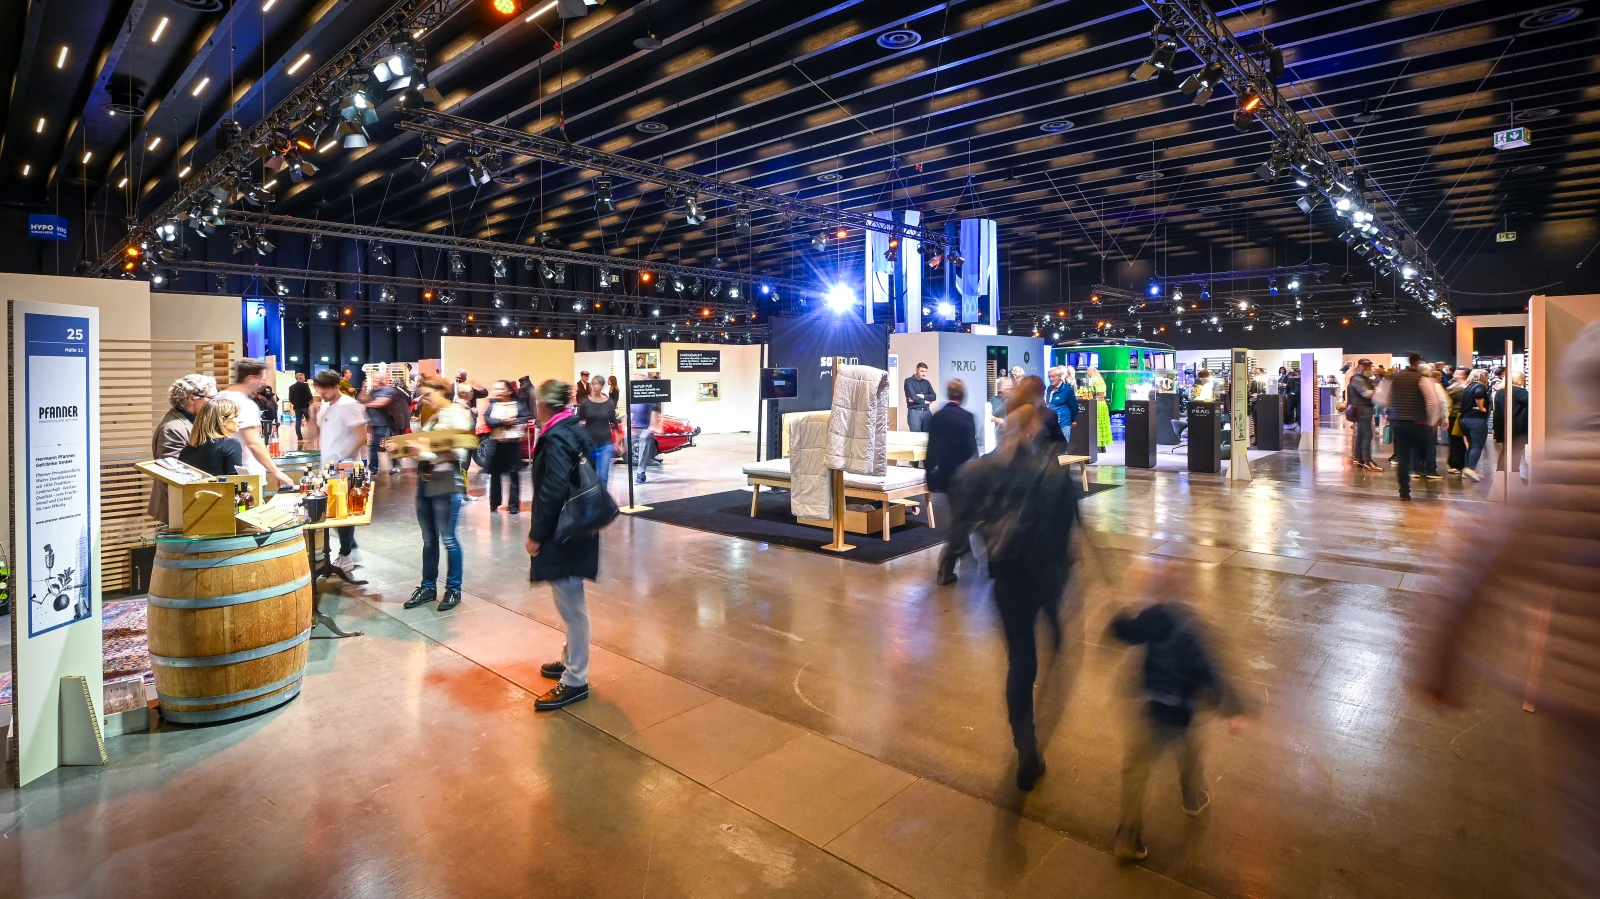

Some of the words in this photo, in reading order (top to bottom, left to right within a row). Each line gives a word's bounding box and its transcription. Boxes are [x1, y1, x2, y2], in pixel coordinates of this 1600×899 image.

[67, 328, 83, 340] 25
[951, 360, 976, 372] PRAG
[38, 406, 78, 419] PFANNER
